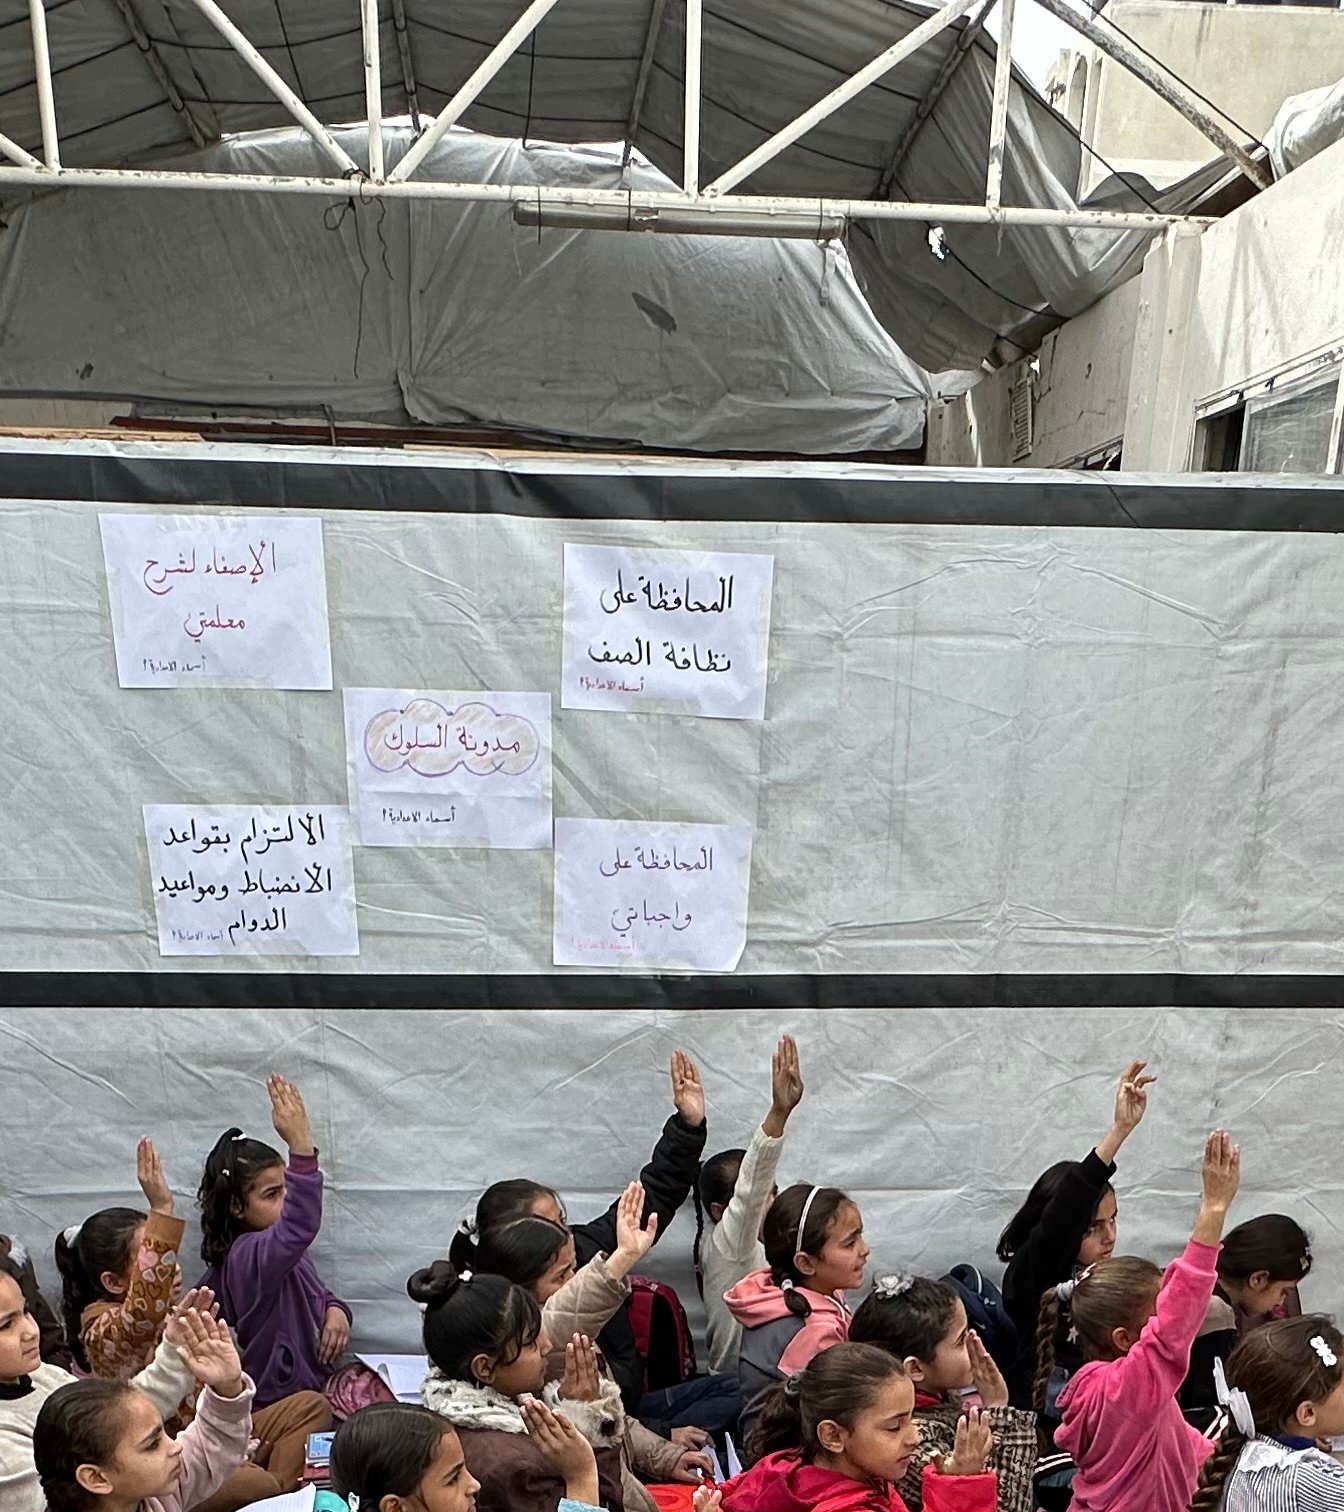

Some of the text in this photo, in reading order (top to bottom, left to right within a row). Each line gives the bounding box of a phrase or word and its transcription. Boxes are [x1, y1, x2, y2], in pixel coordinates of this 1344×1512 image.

[143, 547, 197, 596] لشرح
[599, 568, 734, 614] المحافظة على
[183, 604, 246, 643] معلمتي
[587, 636, 732, 673] نظافة الصف
[383, 723, 521, 757] مدونة السلوك
[162, 817, 231, 854] بقواعد
[157, 870, 229, 903] ومواعيد
[227, 906, 287, 947] الدوام
[611, 899, 692, 938] واجباتي
